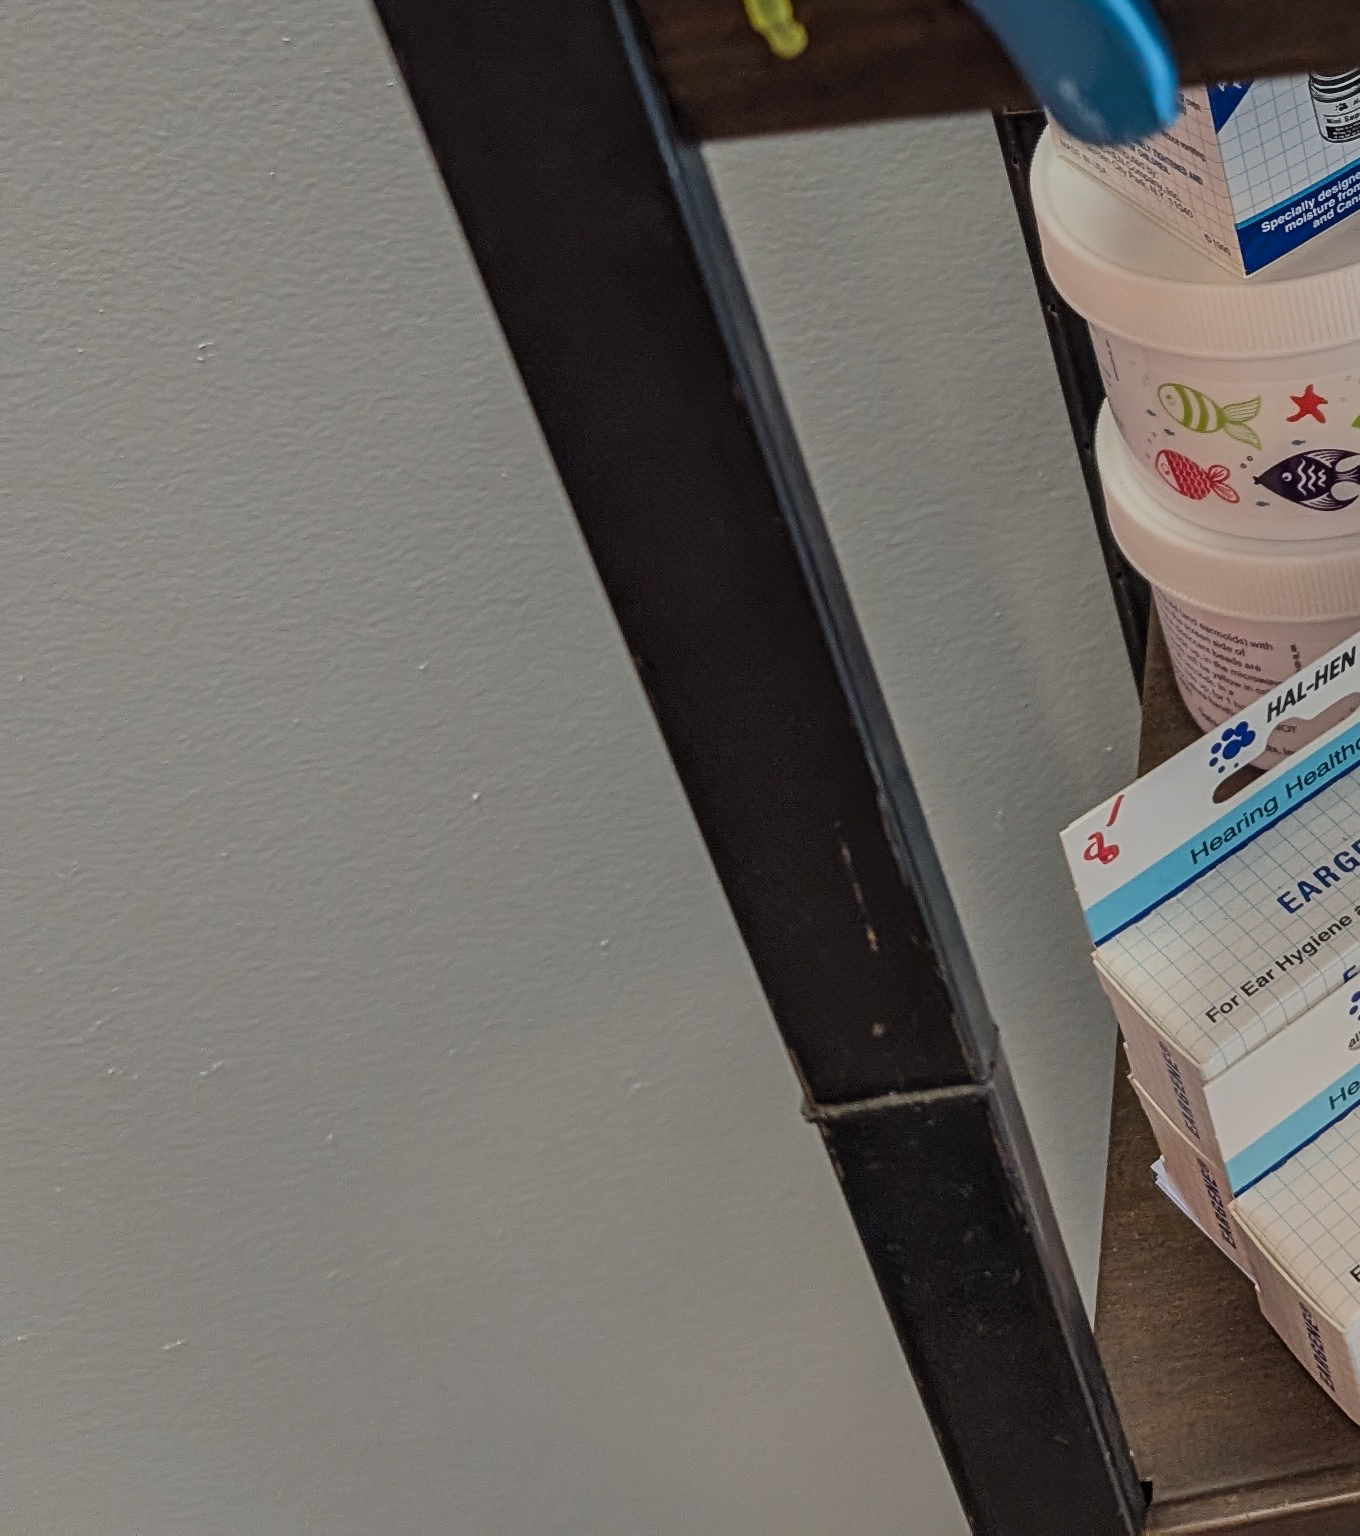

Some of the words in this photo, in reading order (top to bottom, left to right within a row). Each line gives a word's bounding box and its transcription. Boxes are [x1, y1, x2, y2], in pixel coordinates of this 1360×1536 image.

[1261, 197, 1316, 234] Specially
[1285, 199, 1336, 233] moisture
[1312, 211, 1335, 229] and
[1266, 645, 1357, 723] HAL-HEN
[1190, 794, 1280, 865] Hearing
[1204, 992, 1241, 1024] For
[1239, 968, 1276, 1000] Ear
[1275, 914, 1353, 973] Hygiene
